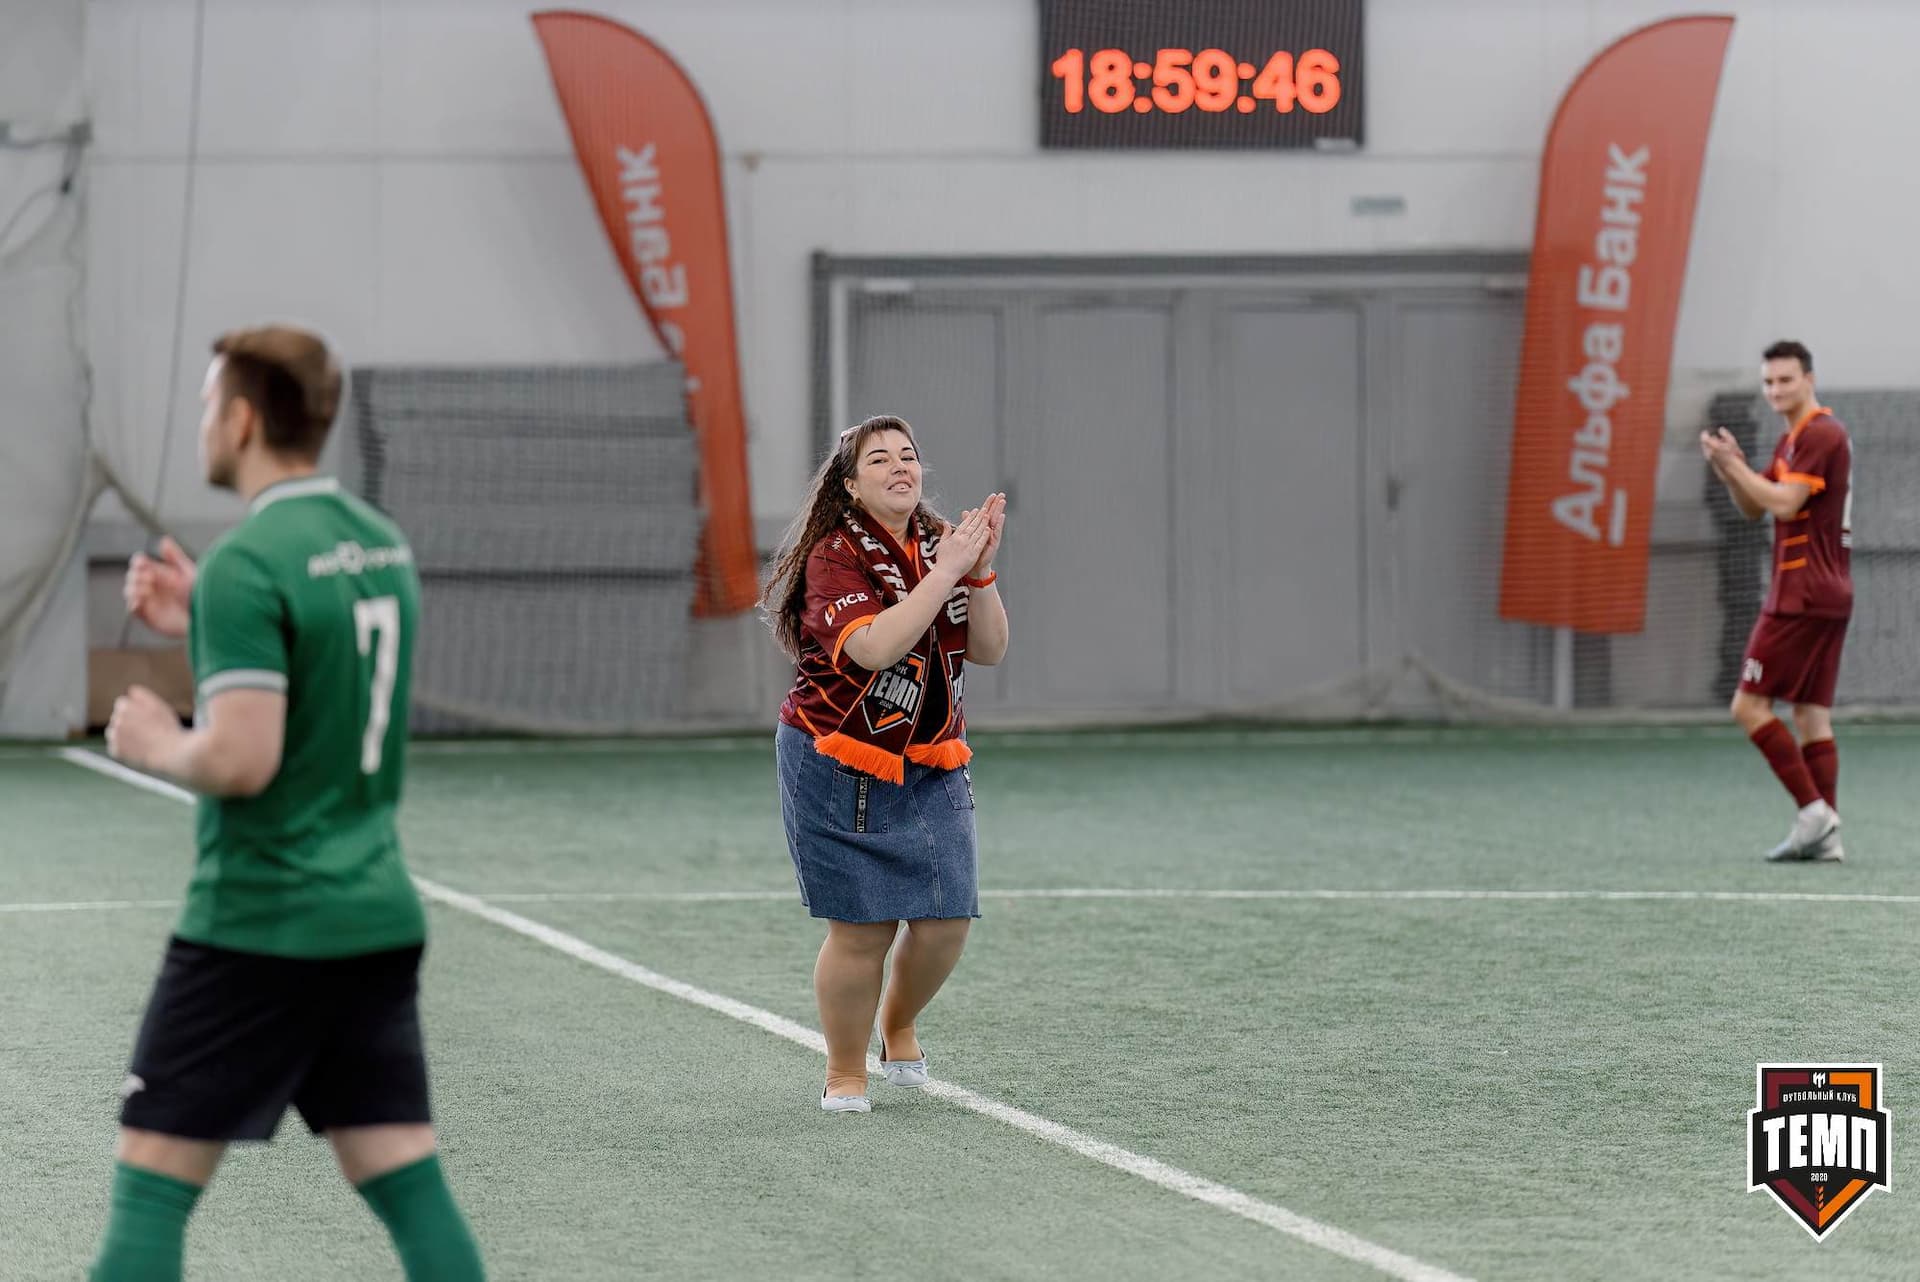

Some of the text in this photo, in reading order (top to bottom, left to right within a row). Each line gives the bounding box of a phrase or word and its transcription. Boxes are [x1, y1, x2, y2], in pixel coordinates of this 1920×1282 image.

[1051, 48, 1341, 114] 18:59:46
[1551, 142, 1650, 545] Альфа Банк
[353, 595, 400, 775] 7
